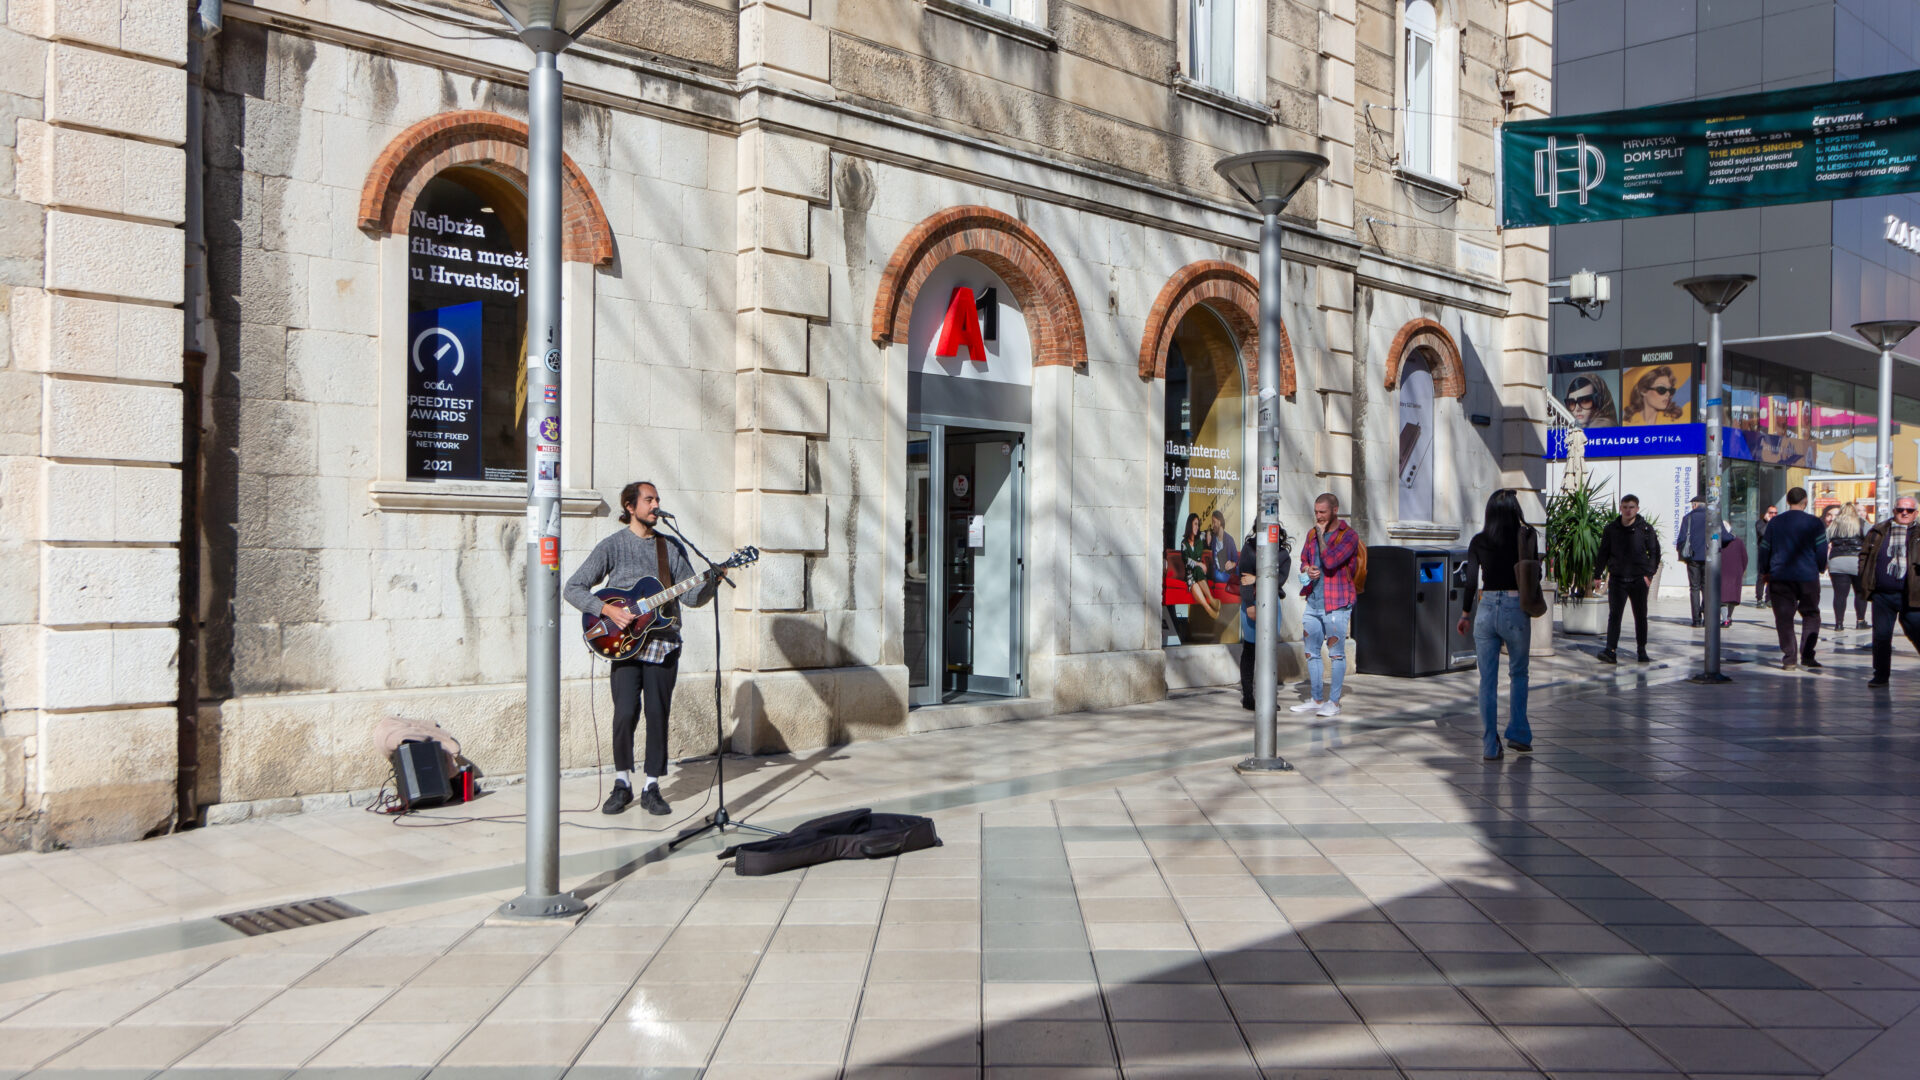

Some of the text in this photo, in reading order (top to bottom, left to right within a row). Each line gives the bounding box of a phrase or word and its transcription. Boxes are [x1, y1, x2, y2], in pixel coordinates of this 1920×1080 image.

[1812, 112, 1864, 126] ČETVRTAK
[1705, 128, 1752, 139] ČETVRTAK
[1825, 134, 1859, 143] EPSTEIN
[1623, 136, 1676, 149] HRVATSKI
[1709, 140, 1804, 158] THE KING'S SINGERS
[1825, 141, 1876, 152] KALMYKOVA
[1624, 147, 1684, 163] DOM SPLIT
[1709, 152, 1792, 167] Vodeći svjetski vokalni
[1709, 160, 1798, 176] sastav prvi put nastupa
[1827, 160, 1870, 171] LESKOVAR
[1888, 155, 1918, 164] FILJAK
[1624, 170, 1683, 181] KONCERTNA DVORANA
[1816, 165, 1911, 181] Odabrala Martina Filjak
[1624, 178, 1663, 188] CONCERT HALL
[412, 209, 485, 238] Najbrža
[411, 236, 473, 262] fiksna
[411, 264, 524, 297] u Hrvatskoj.
[935, 286, 997, 362] A1
[1574, 359, 1602, 368] MaxMara
[1642, 352, 1673, 363] MOSCHINO
[423, 380, 453, 391] OOKLA
[407, 430, 469, 441] FASTEST FIXED
[1644, 435, 1681, 444] OPTIKA
[416, 441, 460, 449] NETWORK
[1190, 442, 1231, 459] internet
[423, 460, 452, 471] 2021
[1172, 463, 1181, 480] je
[1185, 467, 1211, 480] puna
[1214, 466, 1240, 480] kuća.
[1684, 466, 1692, 504] Besplatna
